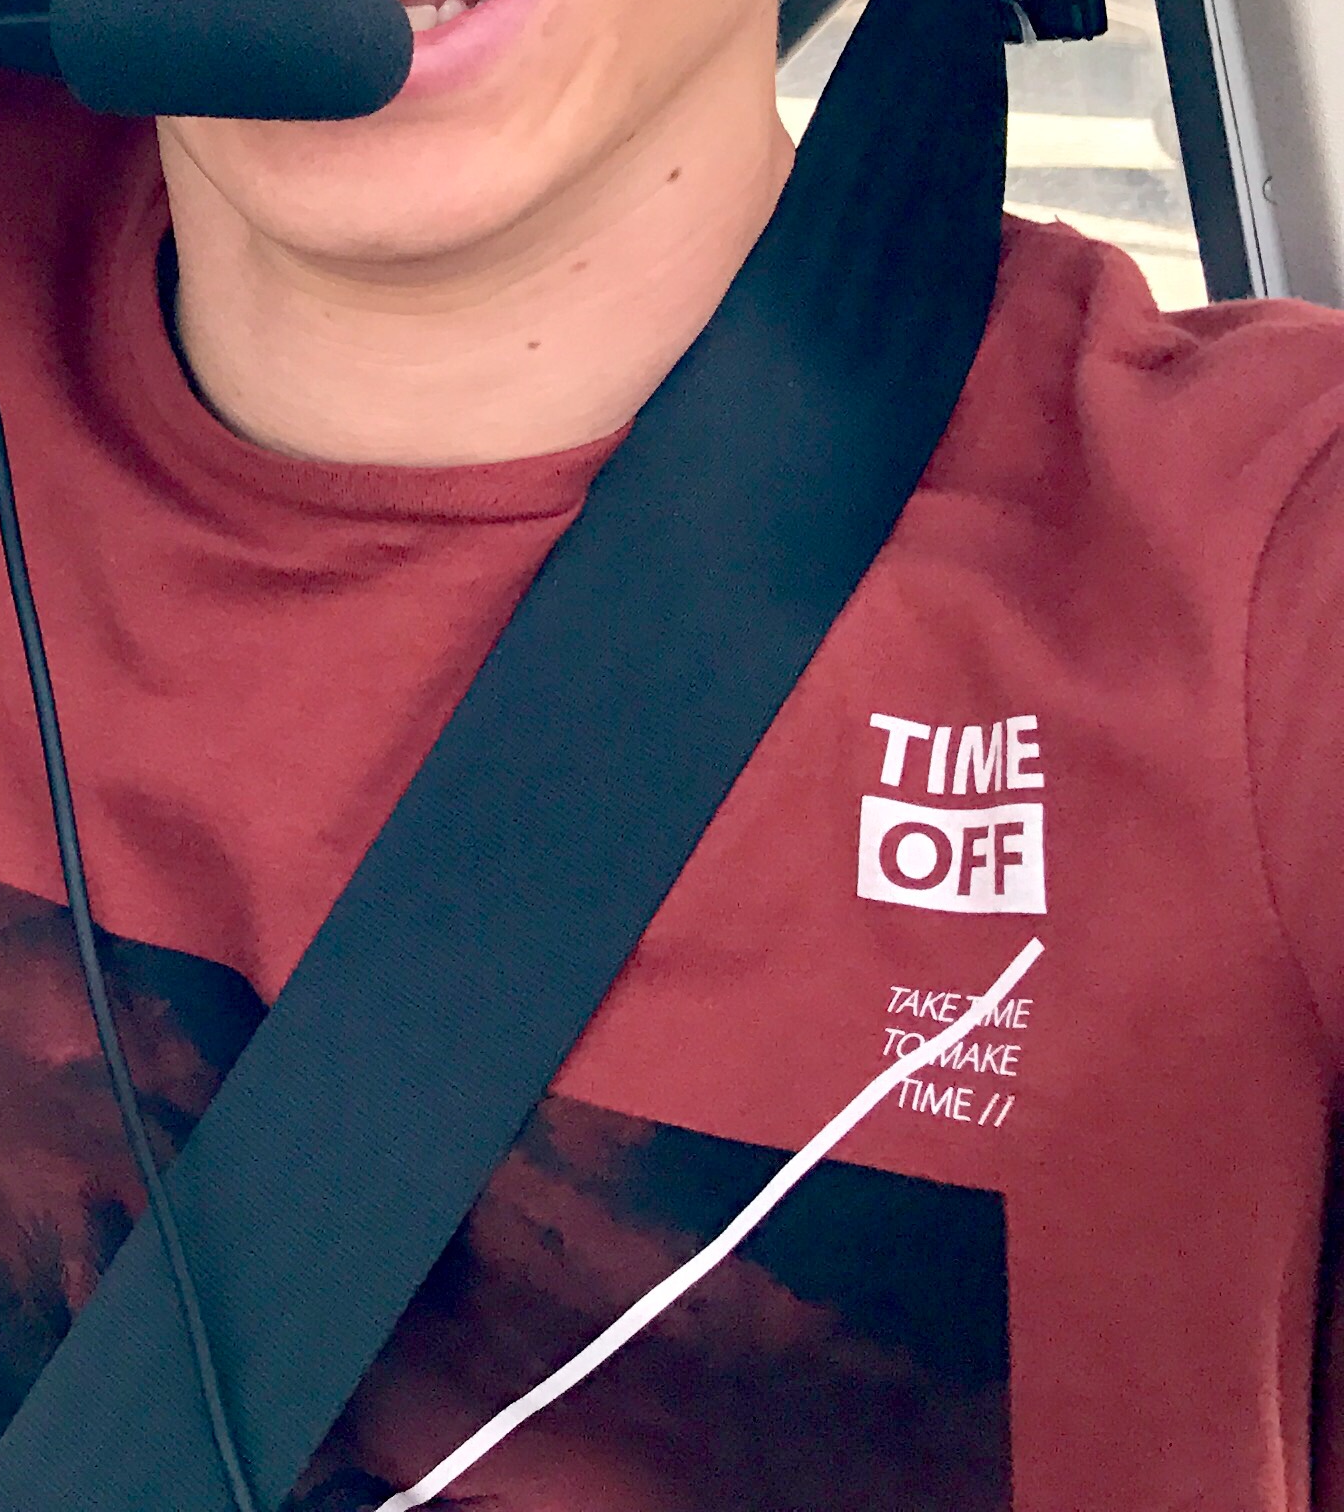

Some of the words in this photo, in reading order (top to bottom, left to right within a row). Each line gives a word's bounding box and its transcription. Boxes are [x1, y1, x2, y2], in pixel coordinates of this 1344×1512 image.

[870, 713, 1044, 795] TIME
[879, 820, 1024, 896] OFF
[886, 984, 962, 1023] TAKE
[966, 996, 1034, 1029] TME
[882, 1026, 926, 1059] TO
[926, 1042, 1023, 1077] MAKE
[897, 1077, 974, 1122] TIME
